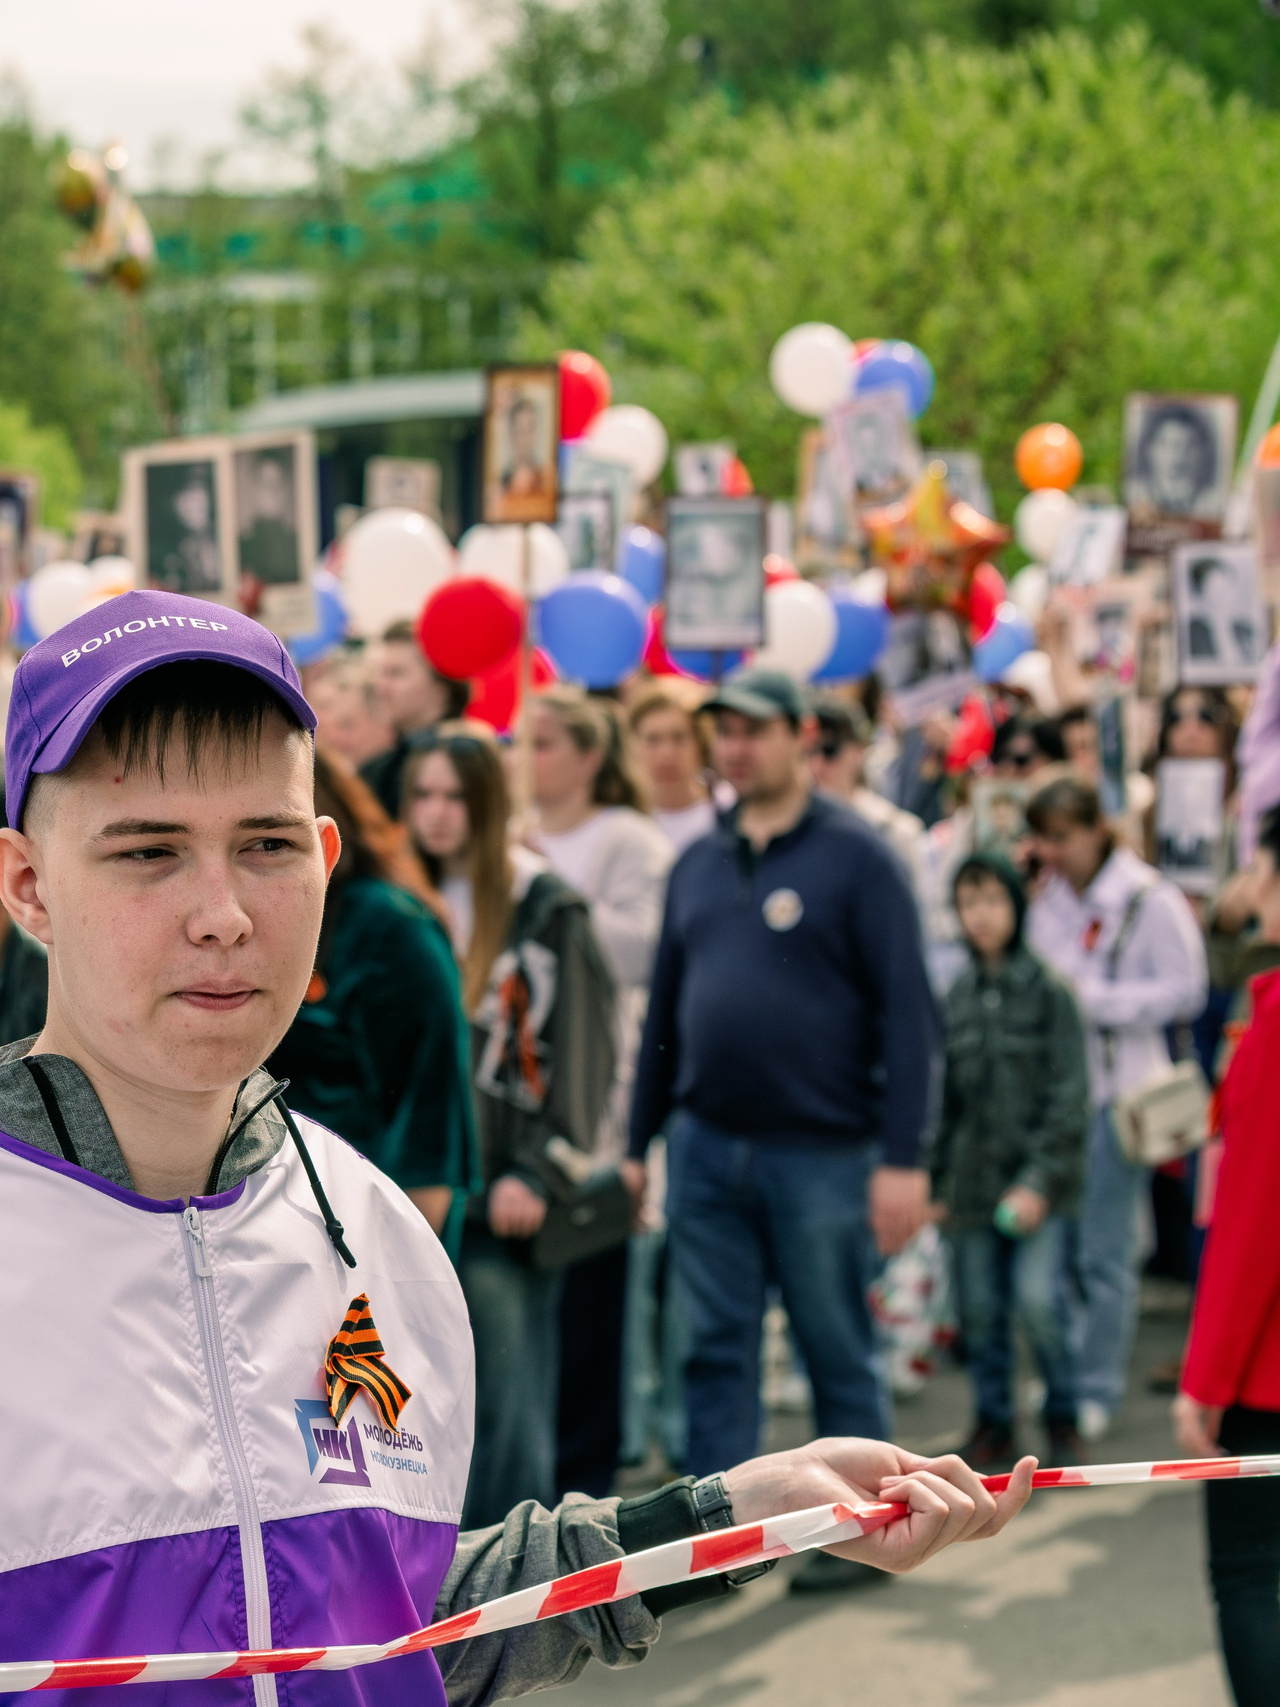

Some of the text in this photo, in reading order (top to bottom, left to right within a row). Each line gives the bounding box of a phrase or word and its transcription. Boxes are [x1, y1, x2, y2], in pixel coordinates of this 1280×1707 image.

[60, 616, 228, 668] ВОЛОНТЕР
[363, 1423, 423, 1452] МОЛОДЁЖЬ
[370, 1450, 428, 1475] НОВОКУЗНЕЦКА
